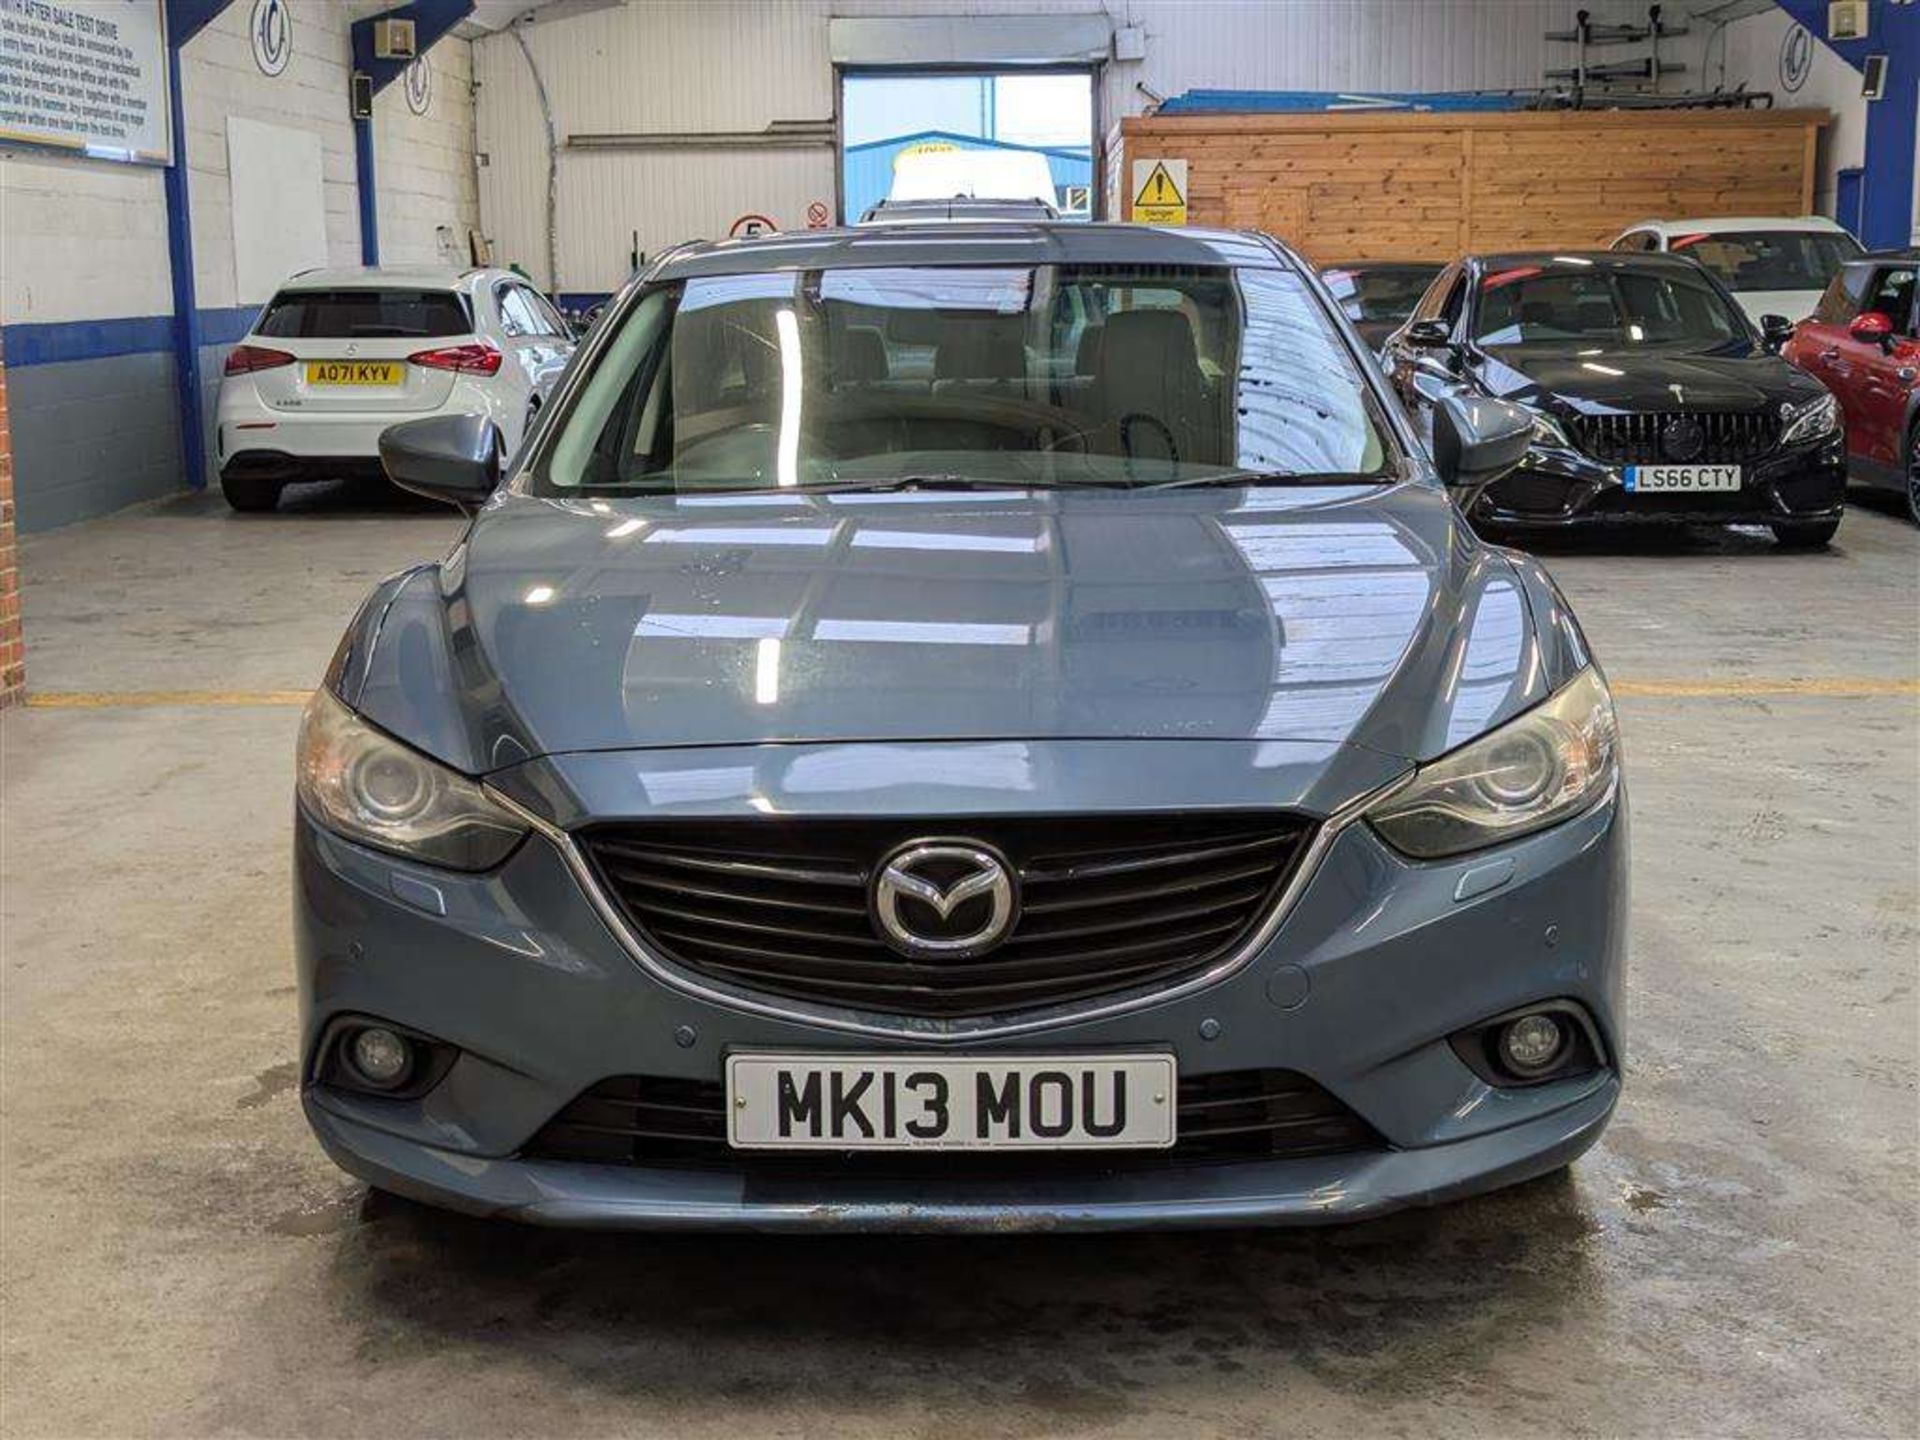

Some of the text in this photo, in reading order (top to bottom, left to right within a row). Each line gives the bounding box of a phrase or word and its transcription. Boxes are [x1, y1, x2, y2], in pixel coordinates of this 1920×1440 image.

[25, 0, 51, 22] AFTER
[53, 7, 74, 28] SALE
[75, 13, 94, 34] TEST
[317, 365, 391, 381] AO71 KYV
[1639, 468, 1692, 488] LS66
[1697, 468, 1736, 487] CTY
[777, 1070, 1127, 1139] MK13 MOU
